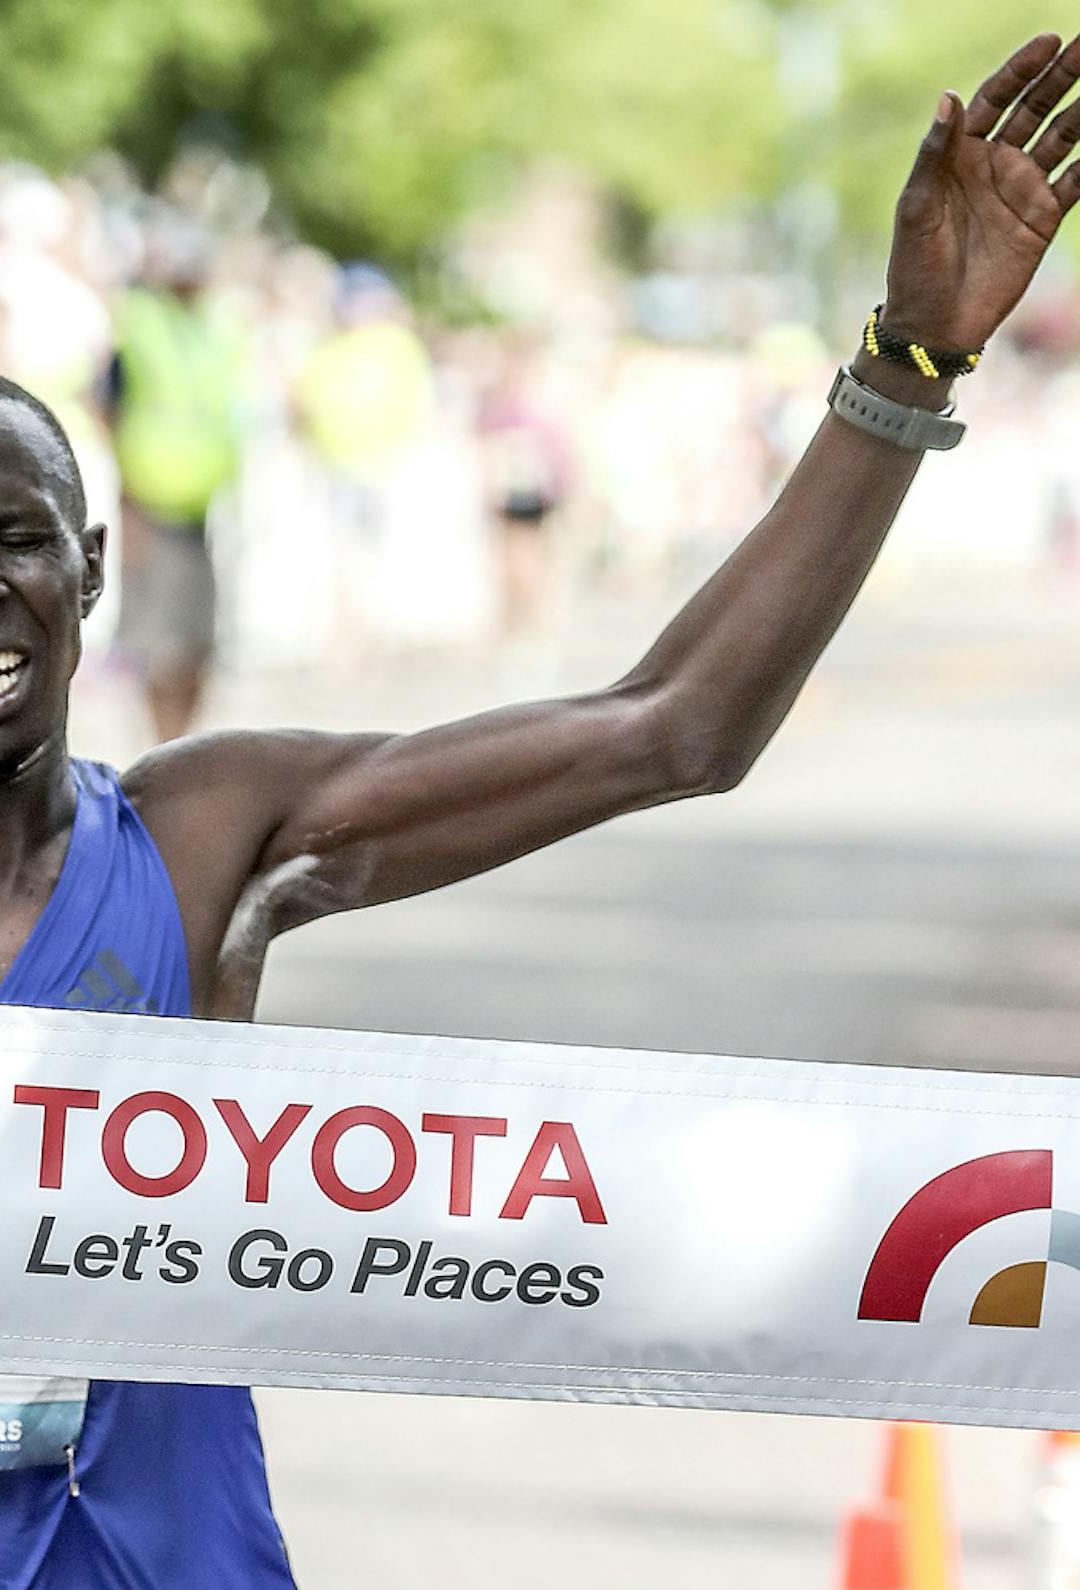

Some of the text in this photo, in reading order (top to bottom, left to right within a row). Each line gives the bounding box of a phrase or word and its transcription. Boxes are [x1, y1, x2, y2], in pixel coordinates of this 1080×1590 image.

[14, 1085, 607, 1224] TOYOTA
[25, 1215, 605, 1308] Let's Go Places
